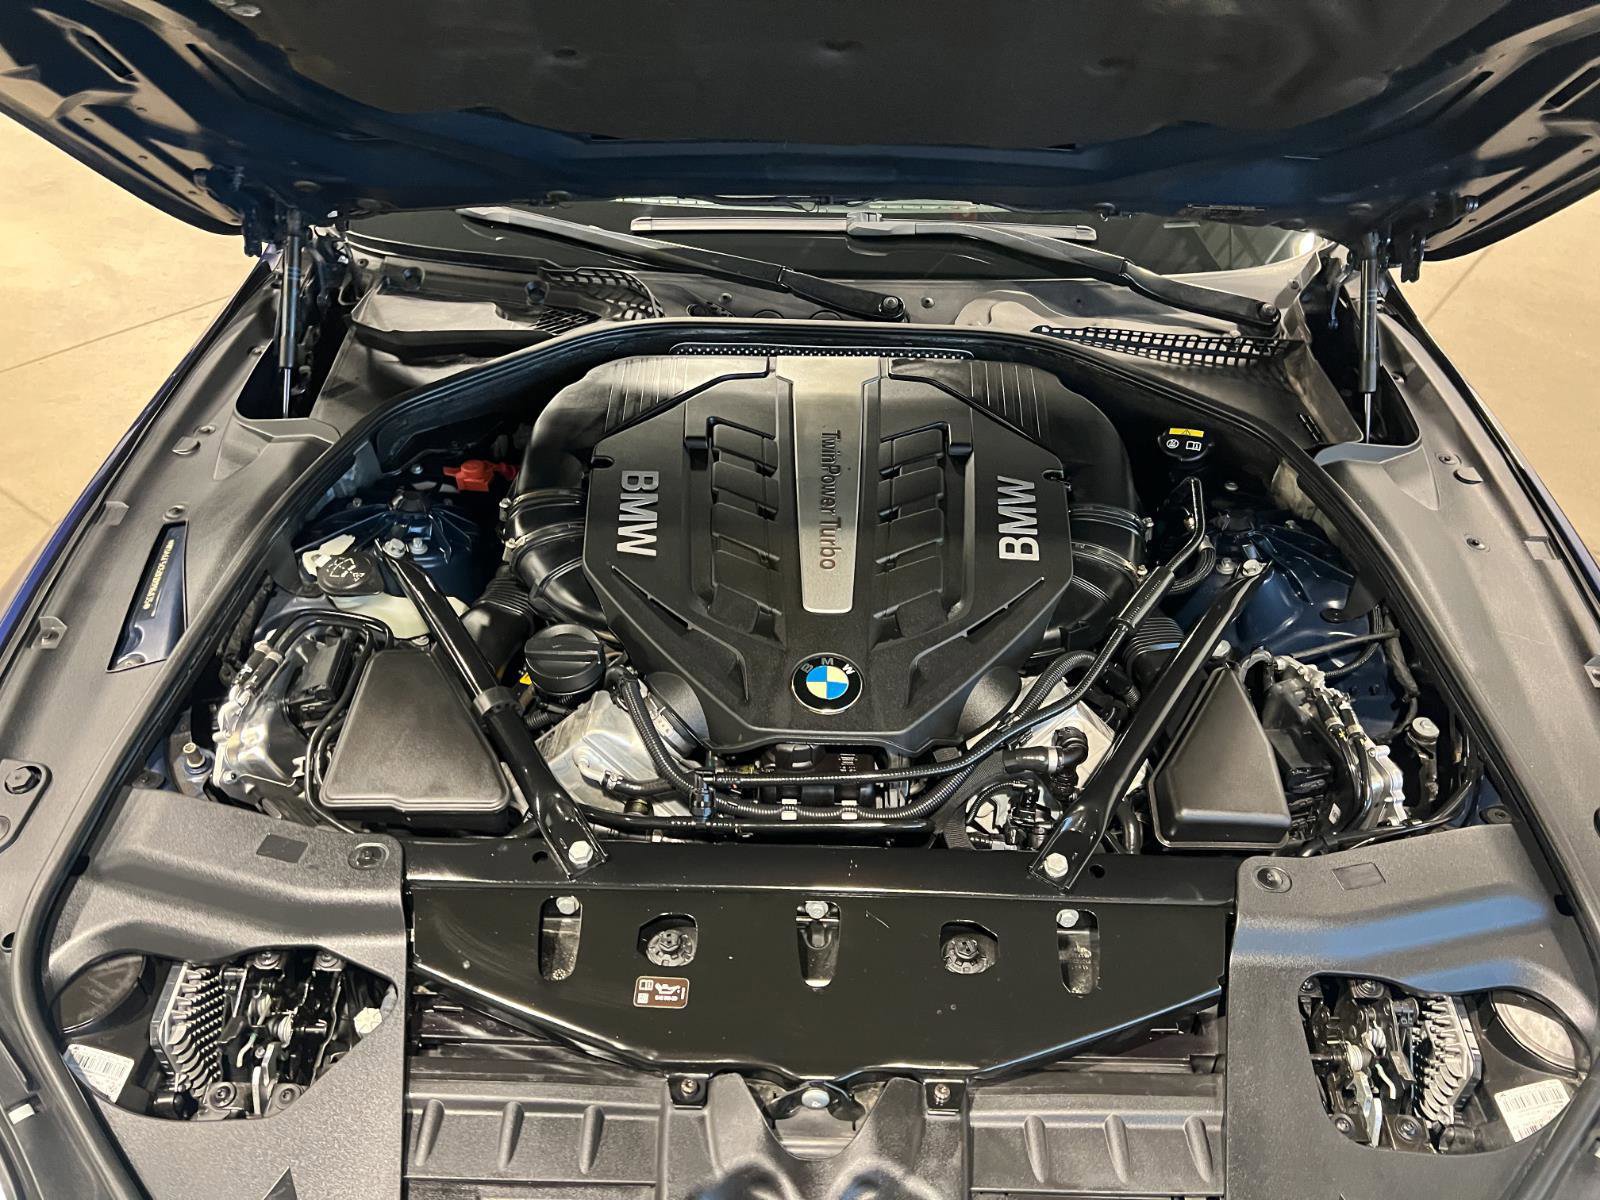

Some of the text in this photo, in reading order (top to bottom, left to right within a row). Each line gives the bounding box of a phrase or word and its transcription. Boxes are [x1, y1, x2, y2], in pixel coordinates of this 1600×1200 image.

[617, 470, 660, 557] BMW
[819, 430, 842, 570] TwinPower Turbo
[997, 475, 1040, 561] BMW
[801, 657, 856, 675] BMW
